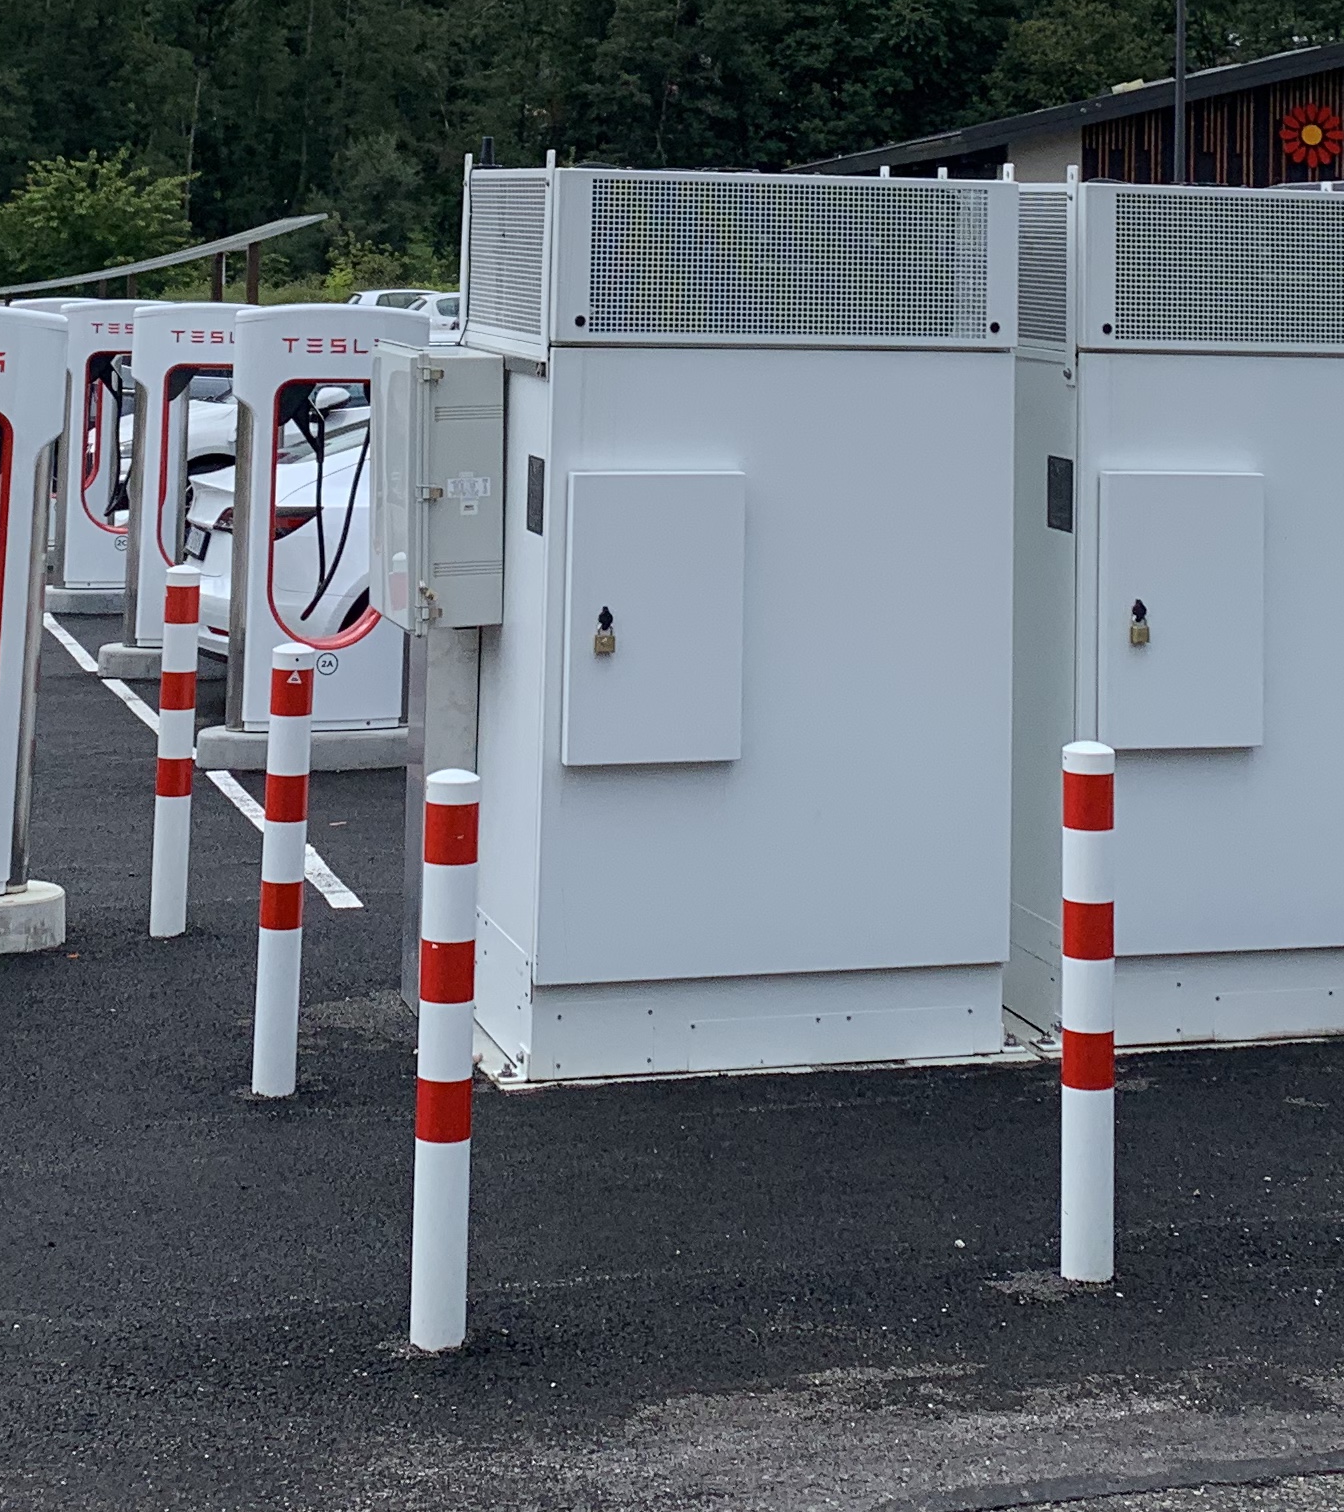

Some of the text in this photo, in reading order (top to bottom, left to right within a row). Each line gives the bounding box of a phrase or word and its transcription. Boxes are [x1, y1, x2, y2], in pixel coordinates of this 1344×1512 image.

[91, 323, 134, 334] TES
[282, 338, 379, 354] TESL
[321, 660, 334, 668] 2A
